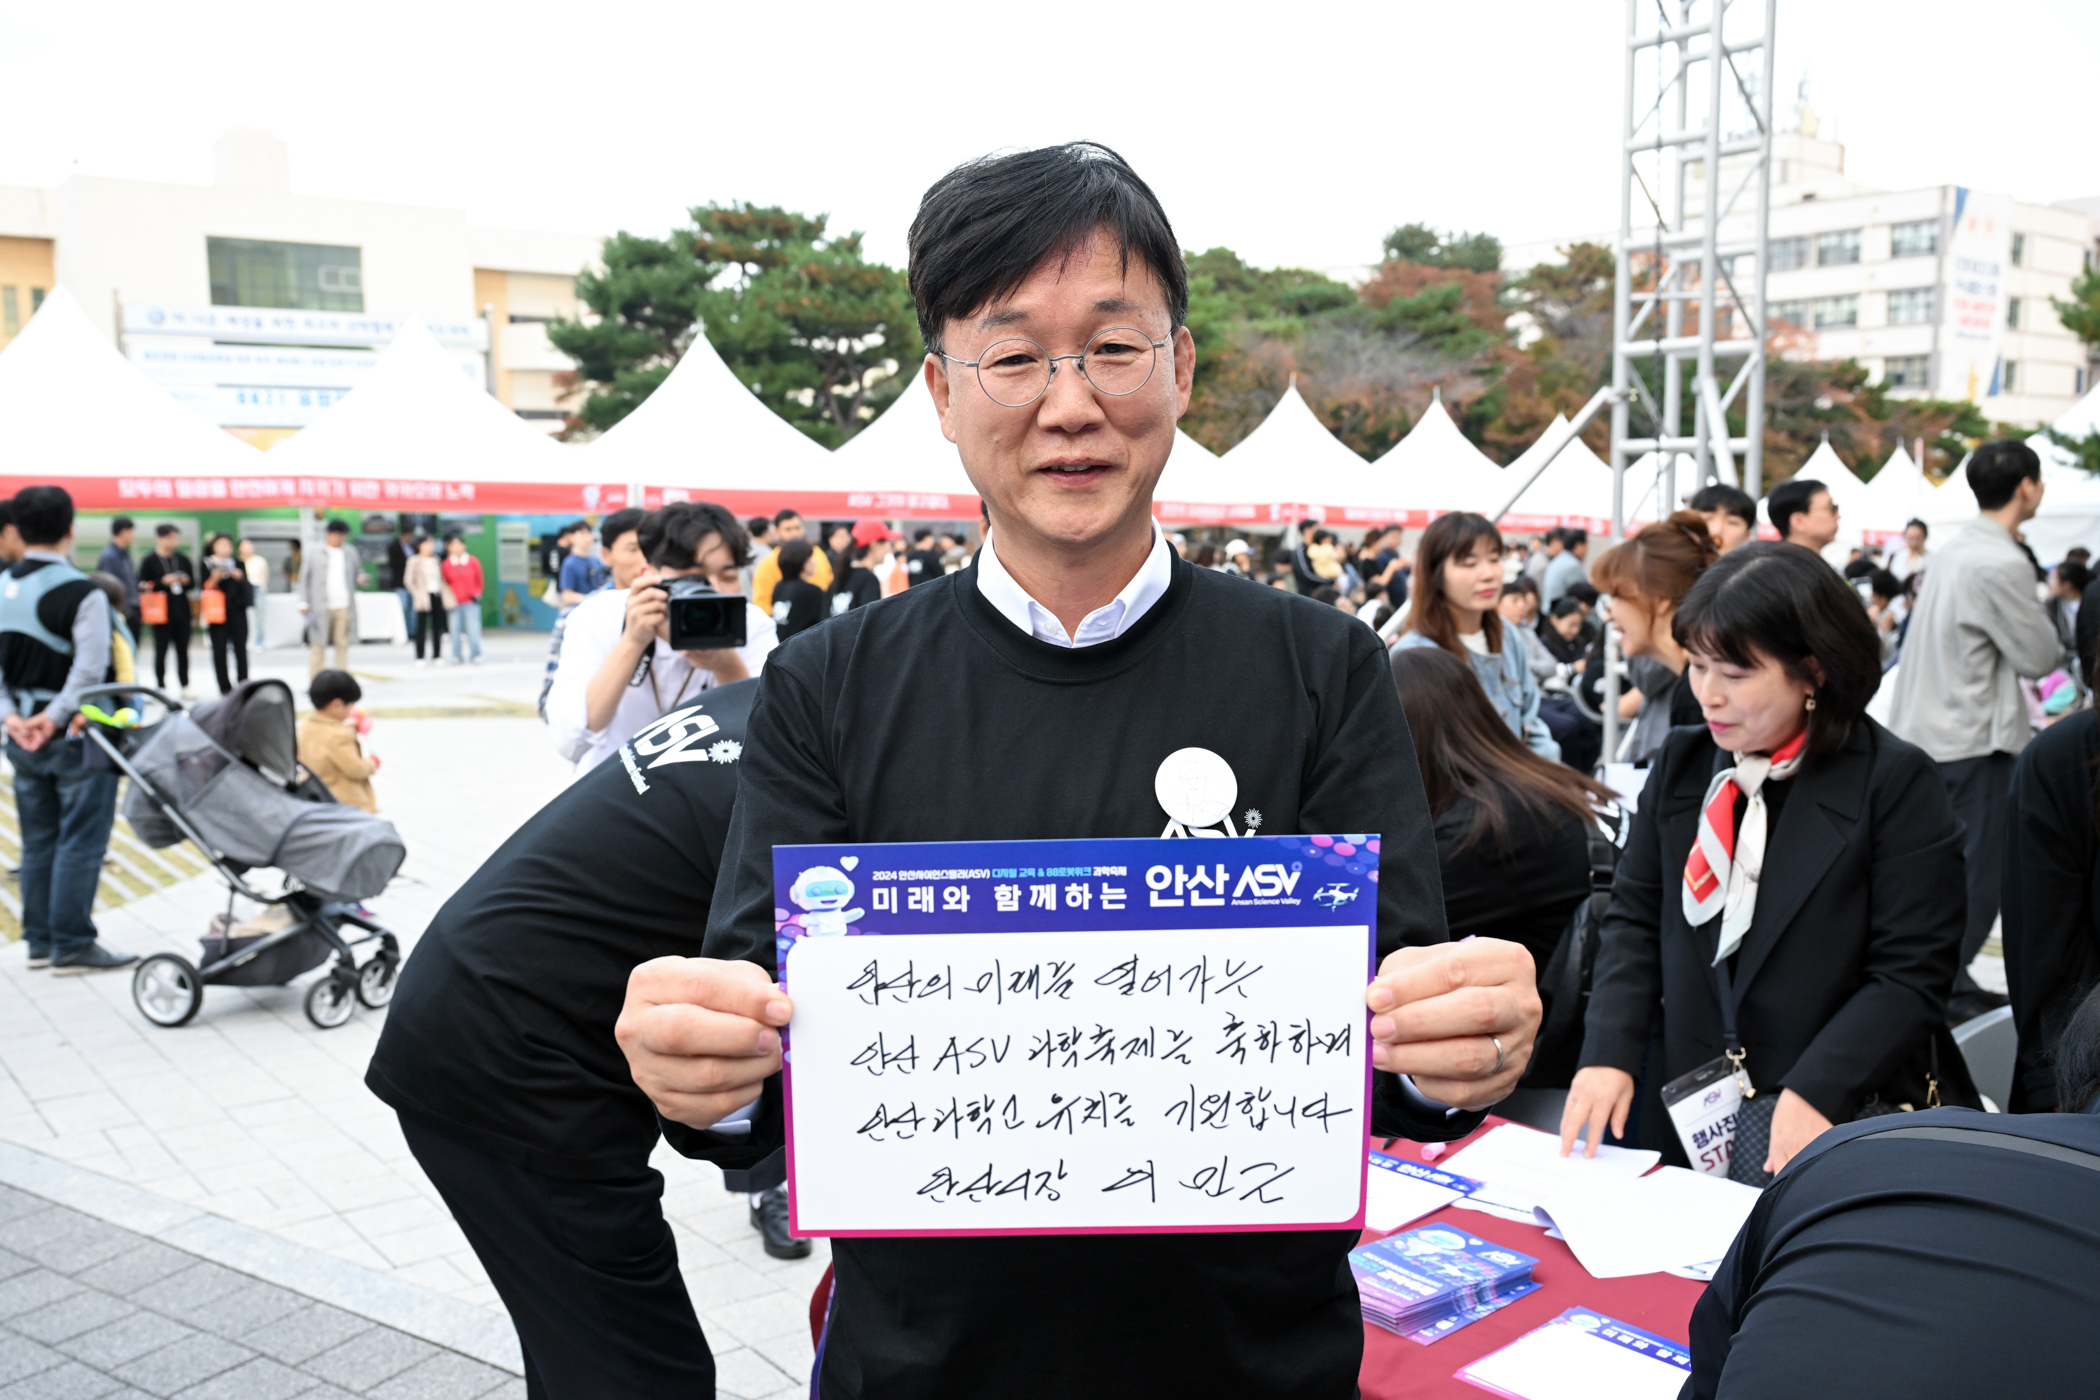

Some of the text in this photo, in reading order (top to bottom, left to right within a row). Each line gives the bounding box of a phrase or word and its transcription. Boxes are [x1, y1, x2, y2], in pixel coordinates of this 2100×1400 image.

[633, 705, 720, 770] ASV
[872, 871, 898, 881] 2024
[898, 869, 991, 881] 안산사이언스밸리(ASV)
[1019, 867, 1036, 878] 교육
[1037, 868, 1045, 877] &
[1093, 866, 1127, 877] 과학축제
[1145, 864, 1301, 907] 안산 ASV
[872, 882, 1127, 914] 미래와 함께하는
[1231, 897, 1302, 906] Ansan Science Valley
[849, 1031, 921, 1076] 안산
[932, 1033, 1011, 1075] ASV
[1164, 1083, 1354, 1133] 기원합니다
[1692, 1113, 1739, 1149] 행사진
[1700, 1139, 1734, 1172] STA
